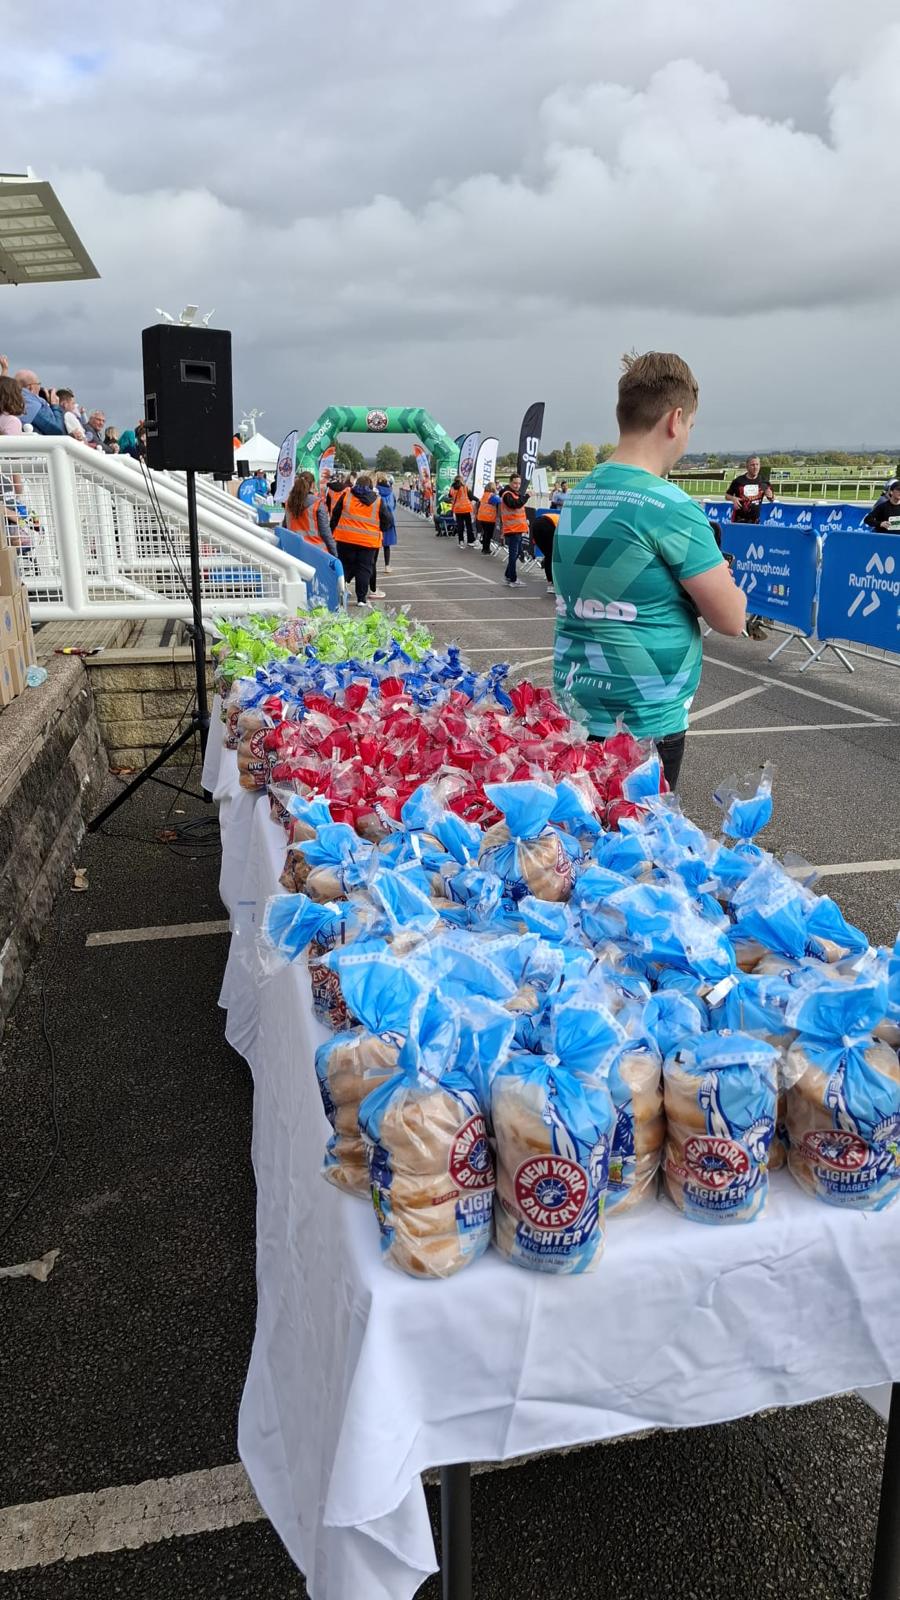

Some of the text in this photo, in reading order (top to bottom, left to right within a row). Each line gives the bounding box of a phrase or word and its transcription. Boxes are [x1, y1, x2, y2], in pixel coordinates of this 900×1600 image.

[306, 419, 332, 452] BROOKS
[736, 559, 790, 577] RunThrough.co.uk
[453, 1126, 475, 1165] NEW
[686, 1140, 745, 1168] NEW YORK
[456, 1168, 496, 1186] BAKE
[519, 1160, 586, 1194] NEW YORK
[817, 1167, 877, 1183] LIGHTER
[458, 1191, 493, 1214] LIGH
[687, 1183, 747, 1201] LIGHTER
[521, 1197, 579, 1225] BAKERY
[519, 1223, 582, 1246] LIGHTER
[520, 1237, 539, 1251] NYC
